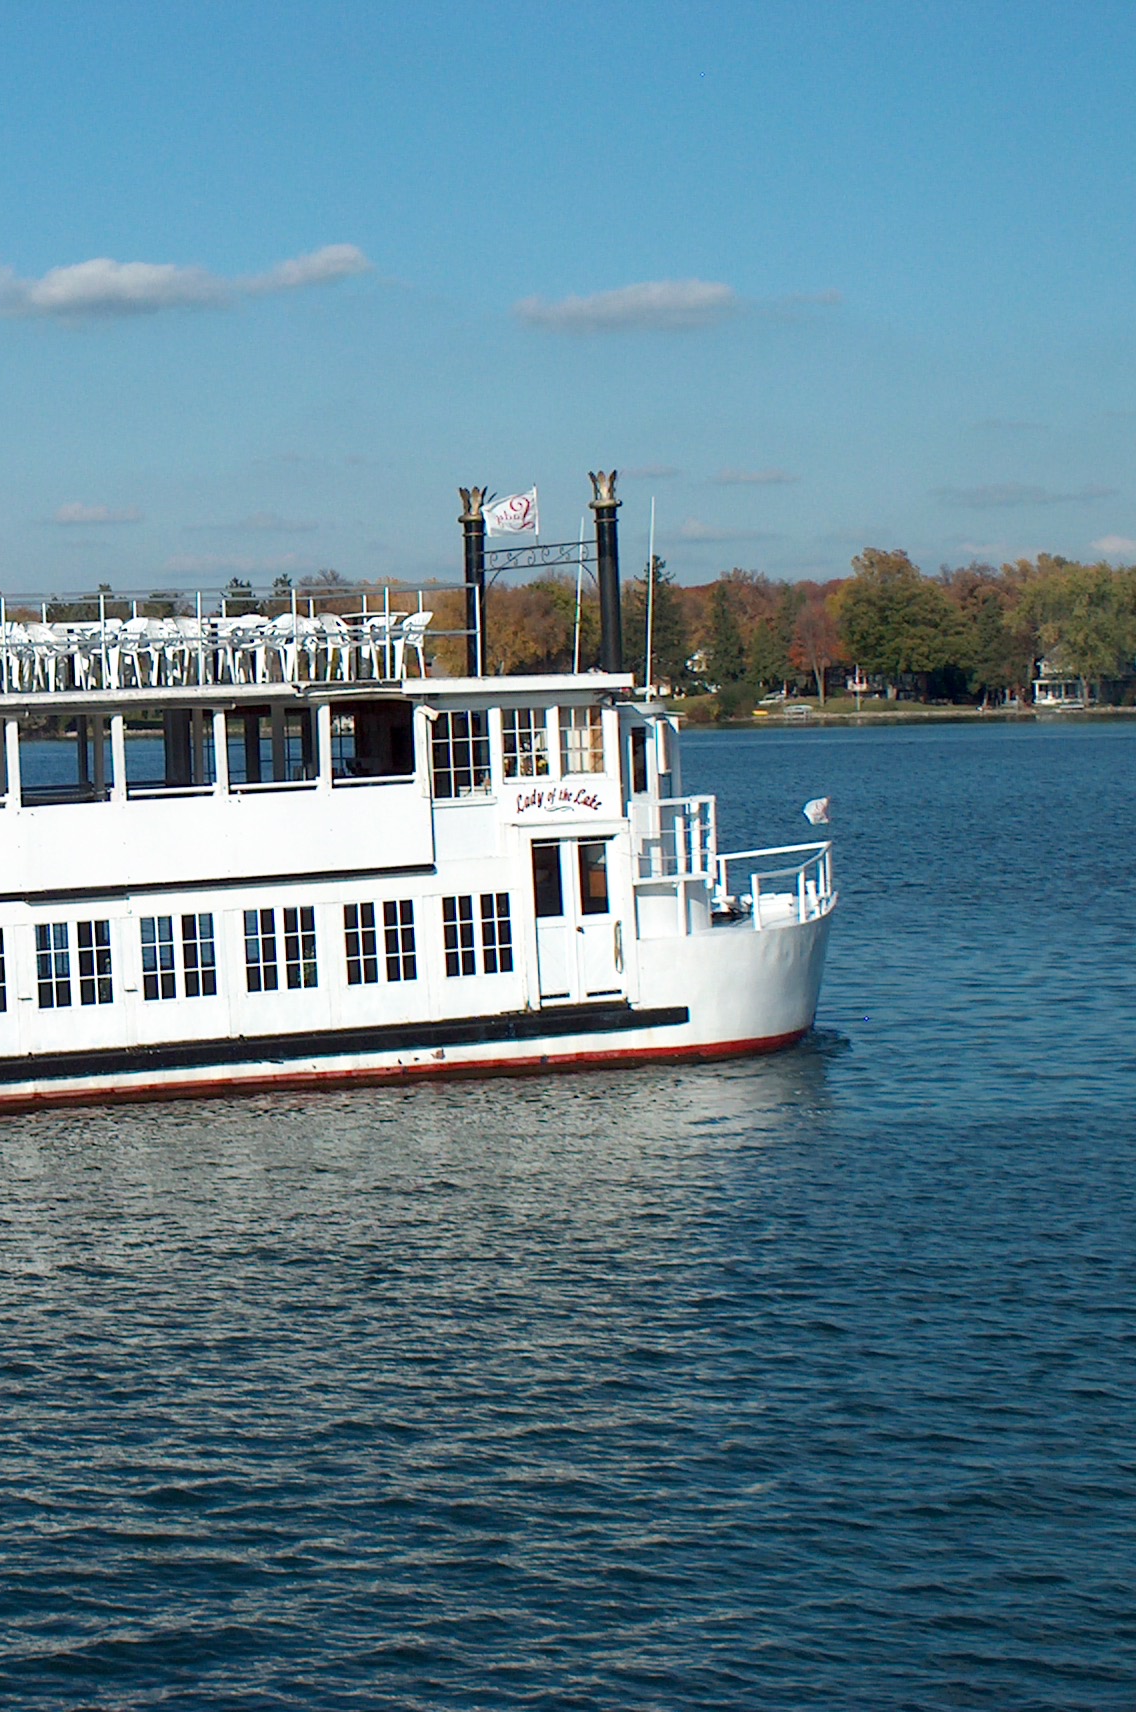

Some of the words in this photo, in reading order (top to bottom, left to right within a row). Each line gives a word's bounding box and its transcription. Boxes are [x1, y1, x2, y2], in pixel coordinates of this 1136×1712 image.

[516, 788, 544, 814] Lady
[547, 787, 557, 805] of
[558, 788, 573, 802] the
[573, 788, 602, 810] Lake
